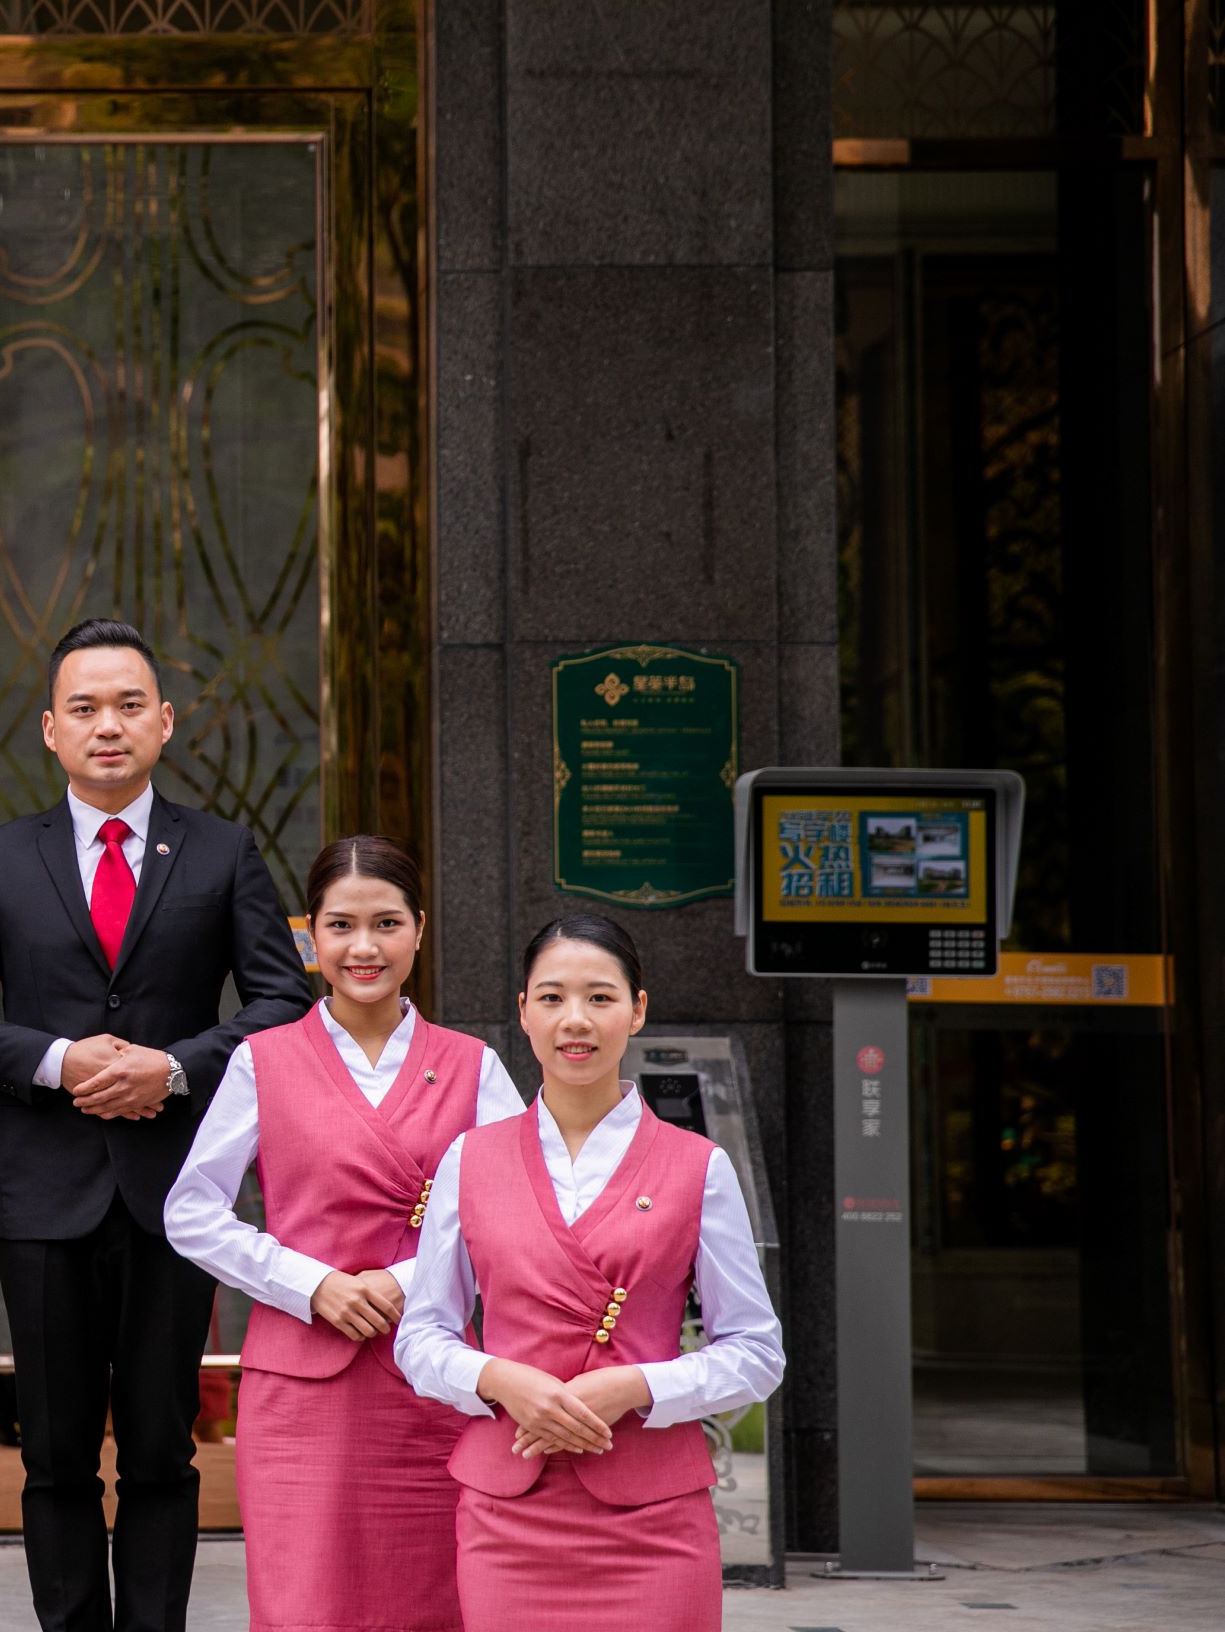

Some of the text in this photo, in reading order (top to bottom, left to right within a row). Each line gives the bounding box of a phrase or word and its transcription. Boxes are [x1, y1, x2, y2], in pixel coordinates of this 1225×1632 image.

[779, 819, 852, 842] 写字楼
[779, 843, 853, 870] 火热
[780, 870, 854, 897] 招租
